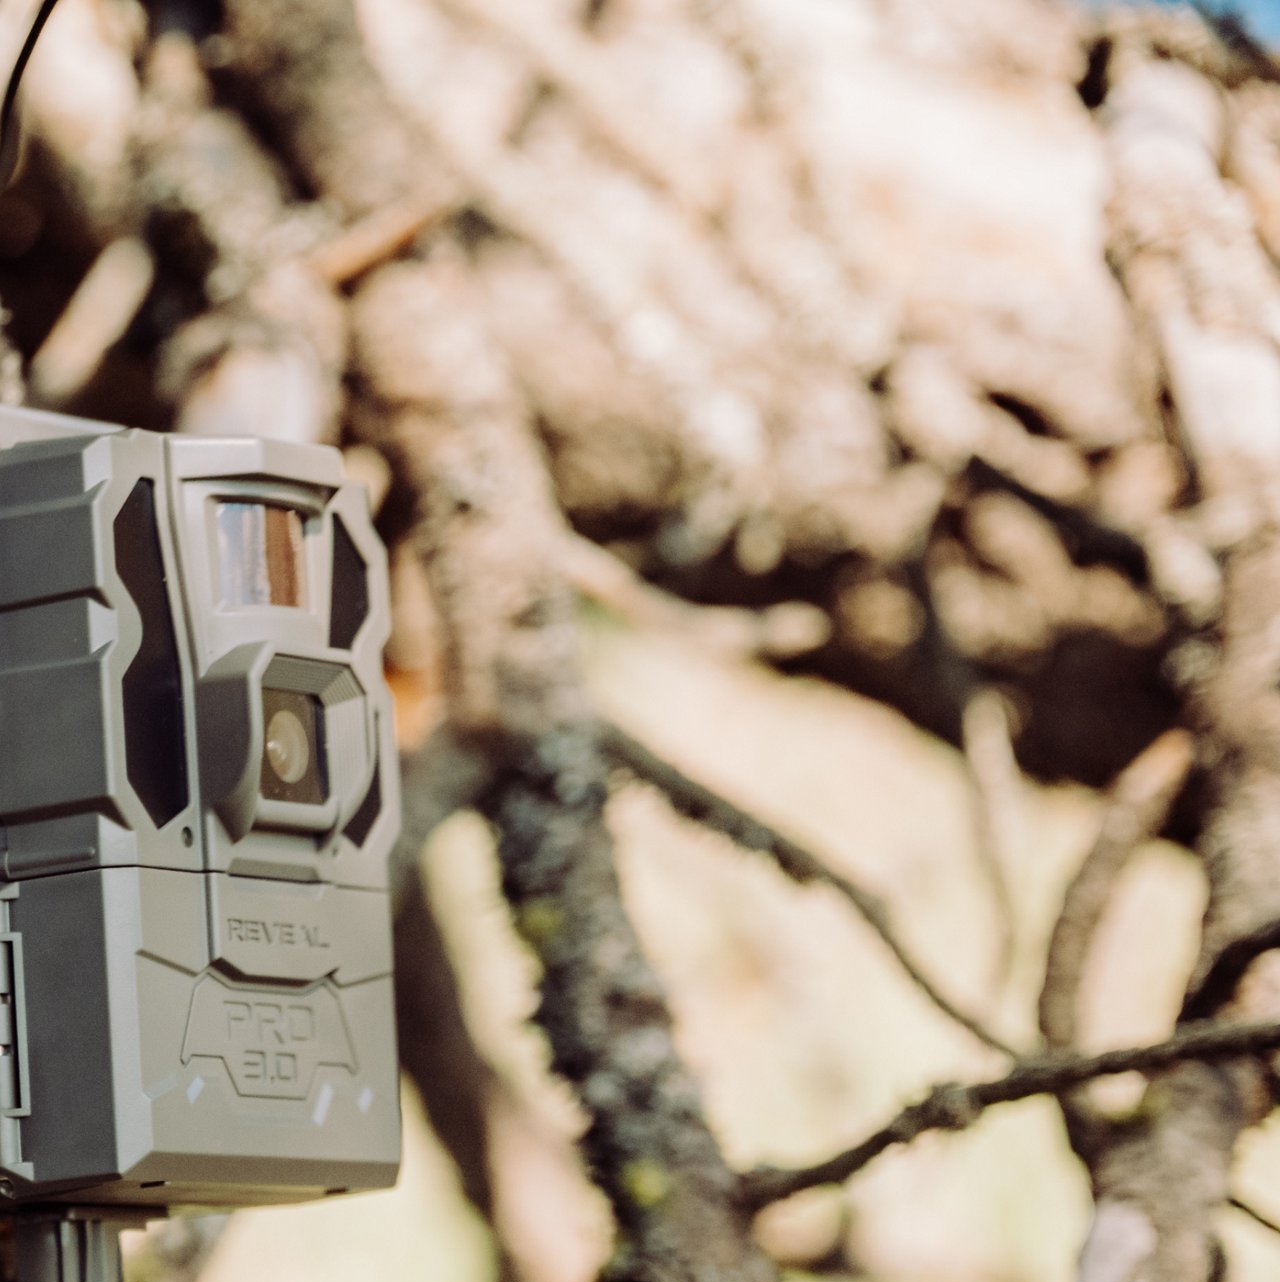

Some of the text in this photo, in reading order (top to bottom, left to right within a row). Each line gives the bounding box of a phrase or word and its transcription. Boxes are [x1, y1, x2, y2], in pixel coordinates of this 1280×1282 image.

[226, 918, 331, 949] REVEAL
[222, 1000, 315, 1045] PRO
[243, 1050, 297, 1083] 3.0
